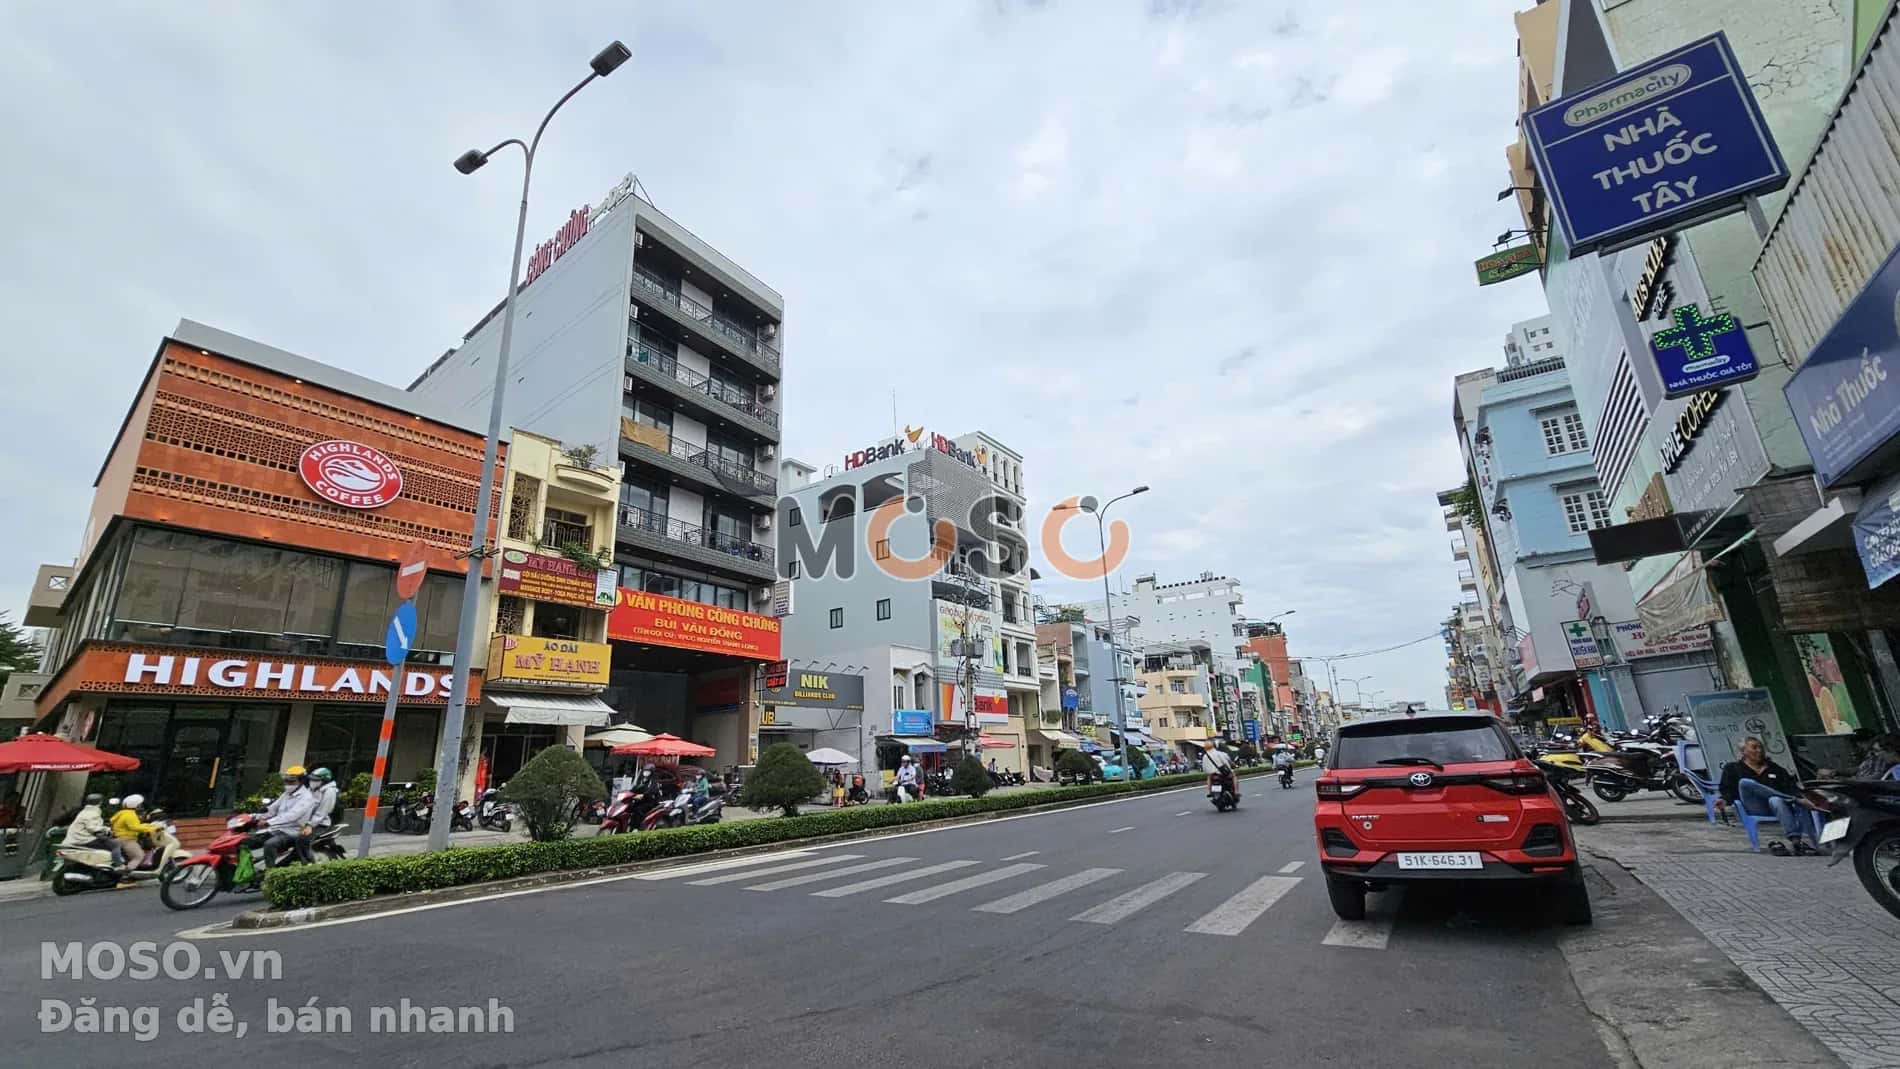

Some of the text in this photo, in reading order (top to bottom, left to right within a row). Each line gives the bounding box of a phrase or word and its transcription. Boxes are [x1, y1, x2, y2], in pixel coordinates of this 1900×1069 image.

[1573, 71, 1681, 122] Pharmacity
[1592, 129, 1718, 190] THUỐC
[1631, 175, 1698, 213] TÂY
[1836, 346, 1887, 410] Thuốc
[308, 443, 398, 480] HIGHLANDS
[845, 438, 905, 471] HDBank
[931, 431, 977, 469] HDBank
[1658, 423, 1685, 472] APPLE
[315, 480, 385, 505] COFFEE
[626, 592, 656, 610] VĂN
[658, 598, 705, 619] PHÒNG
[707, 607, 740, 627] CÔNG
[742, 614, 780, 633] CHỨNG
[654, 617, 678, 630] BÙI
[681, 621, 708, 635] VĂN
[124, 653, 460, 698] HIGHLANDS
[515, 653, 600, 675] MỸ HẠNH
[800, 674, 829, 690] NIK
[1404, 855, 1475, 867] 51K-646.31
